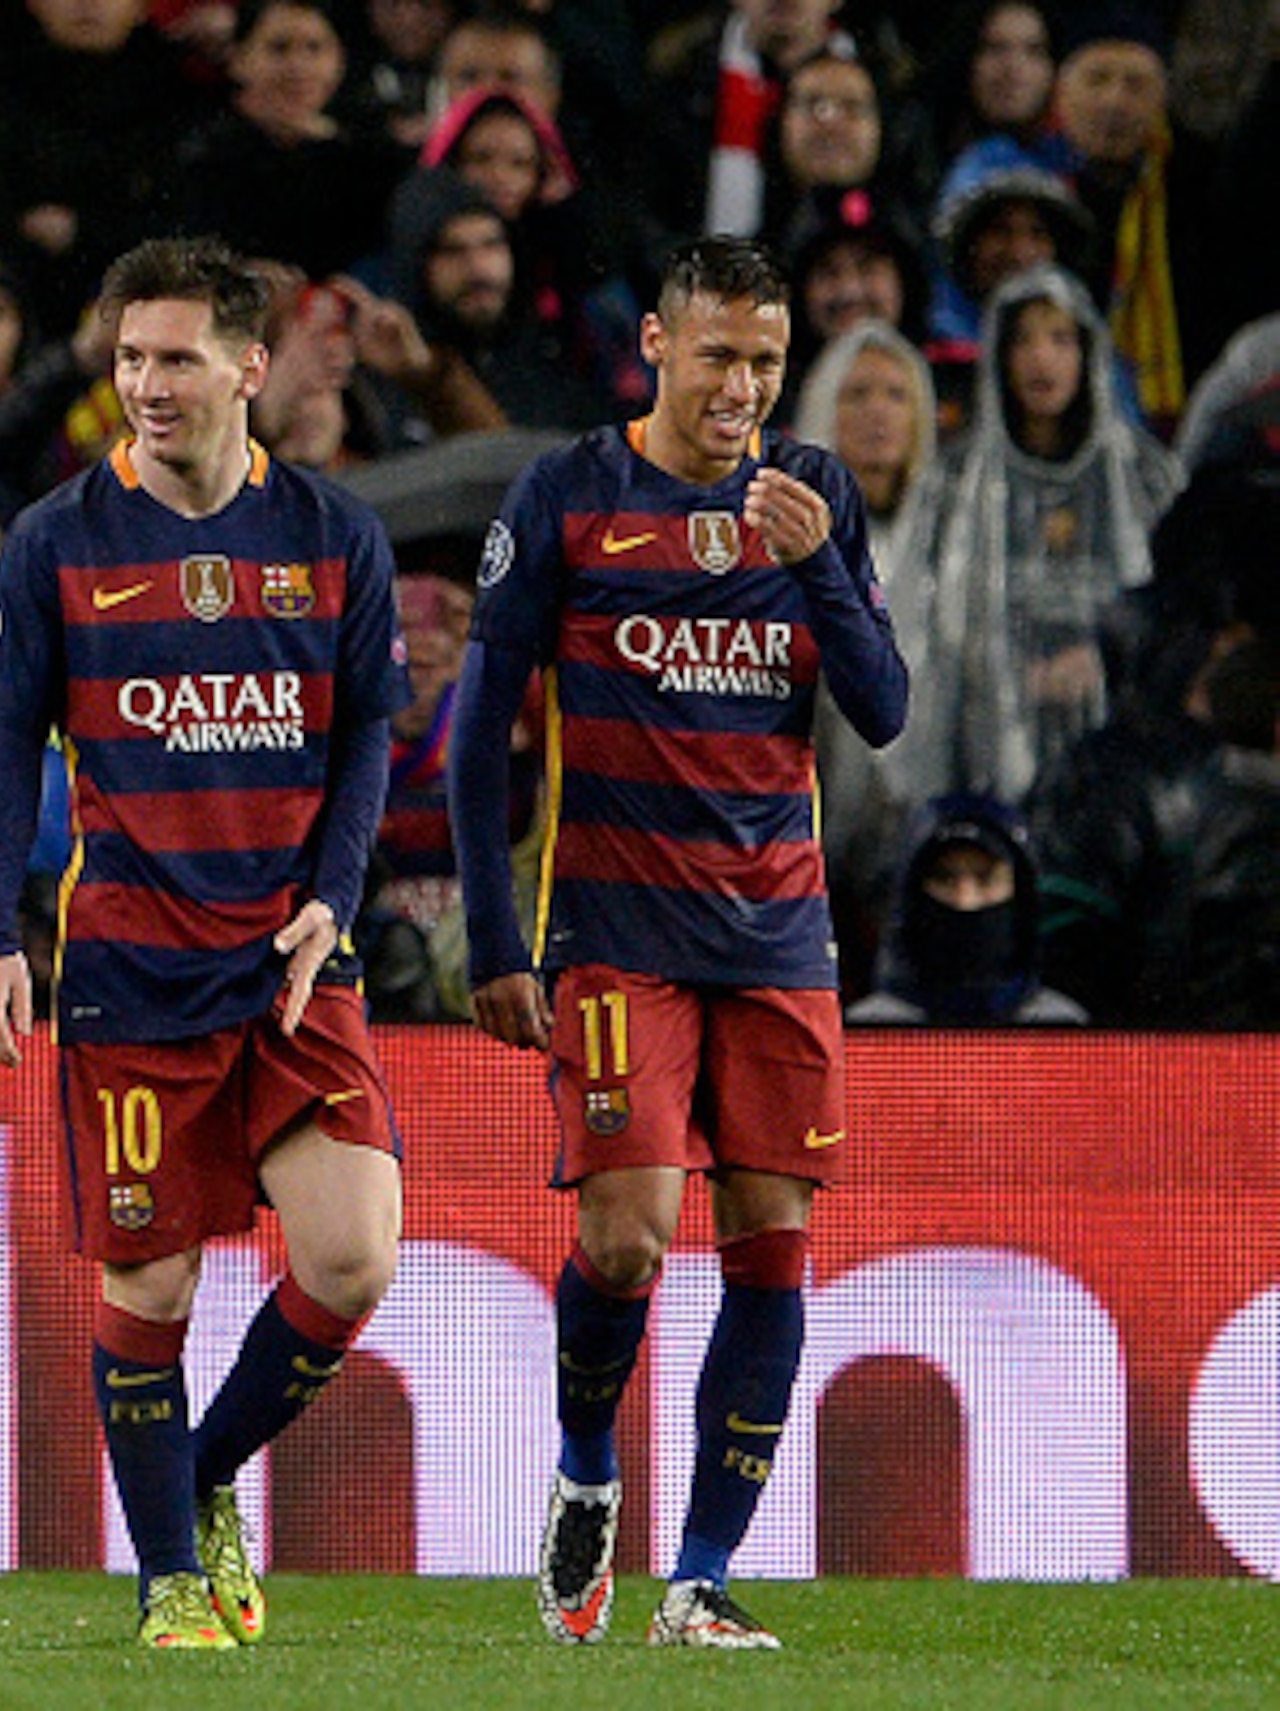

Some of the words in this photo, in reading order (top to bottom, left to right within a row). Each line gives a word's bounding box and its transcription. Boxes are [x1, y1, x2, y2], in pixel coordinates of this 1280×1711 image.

[615, 614, 792, 672] QATAR
[117, 671, 305, 734] QATAR
[165, 718, 305, 753] AIRWAYS
[578, 992, 629, 1080] 11
[97, 1085, 162, 1175] 10
